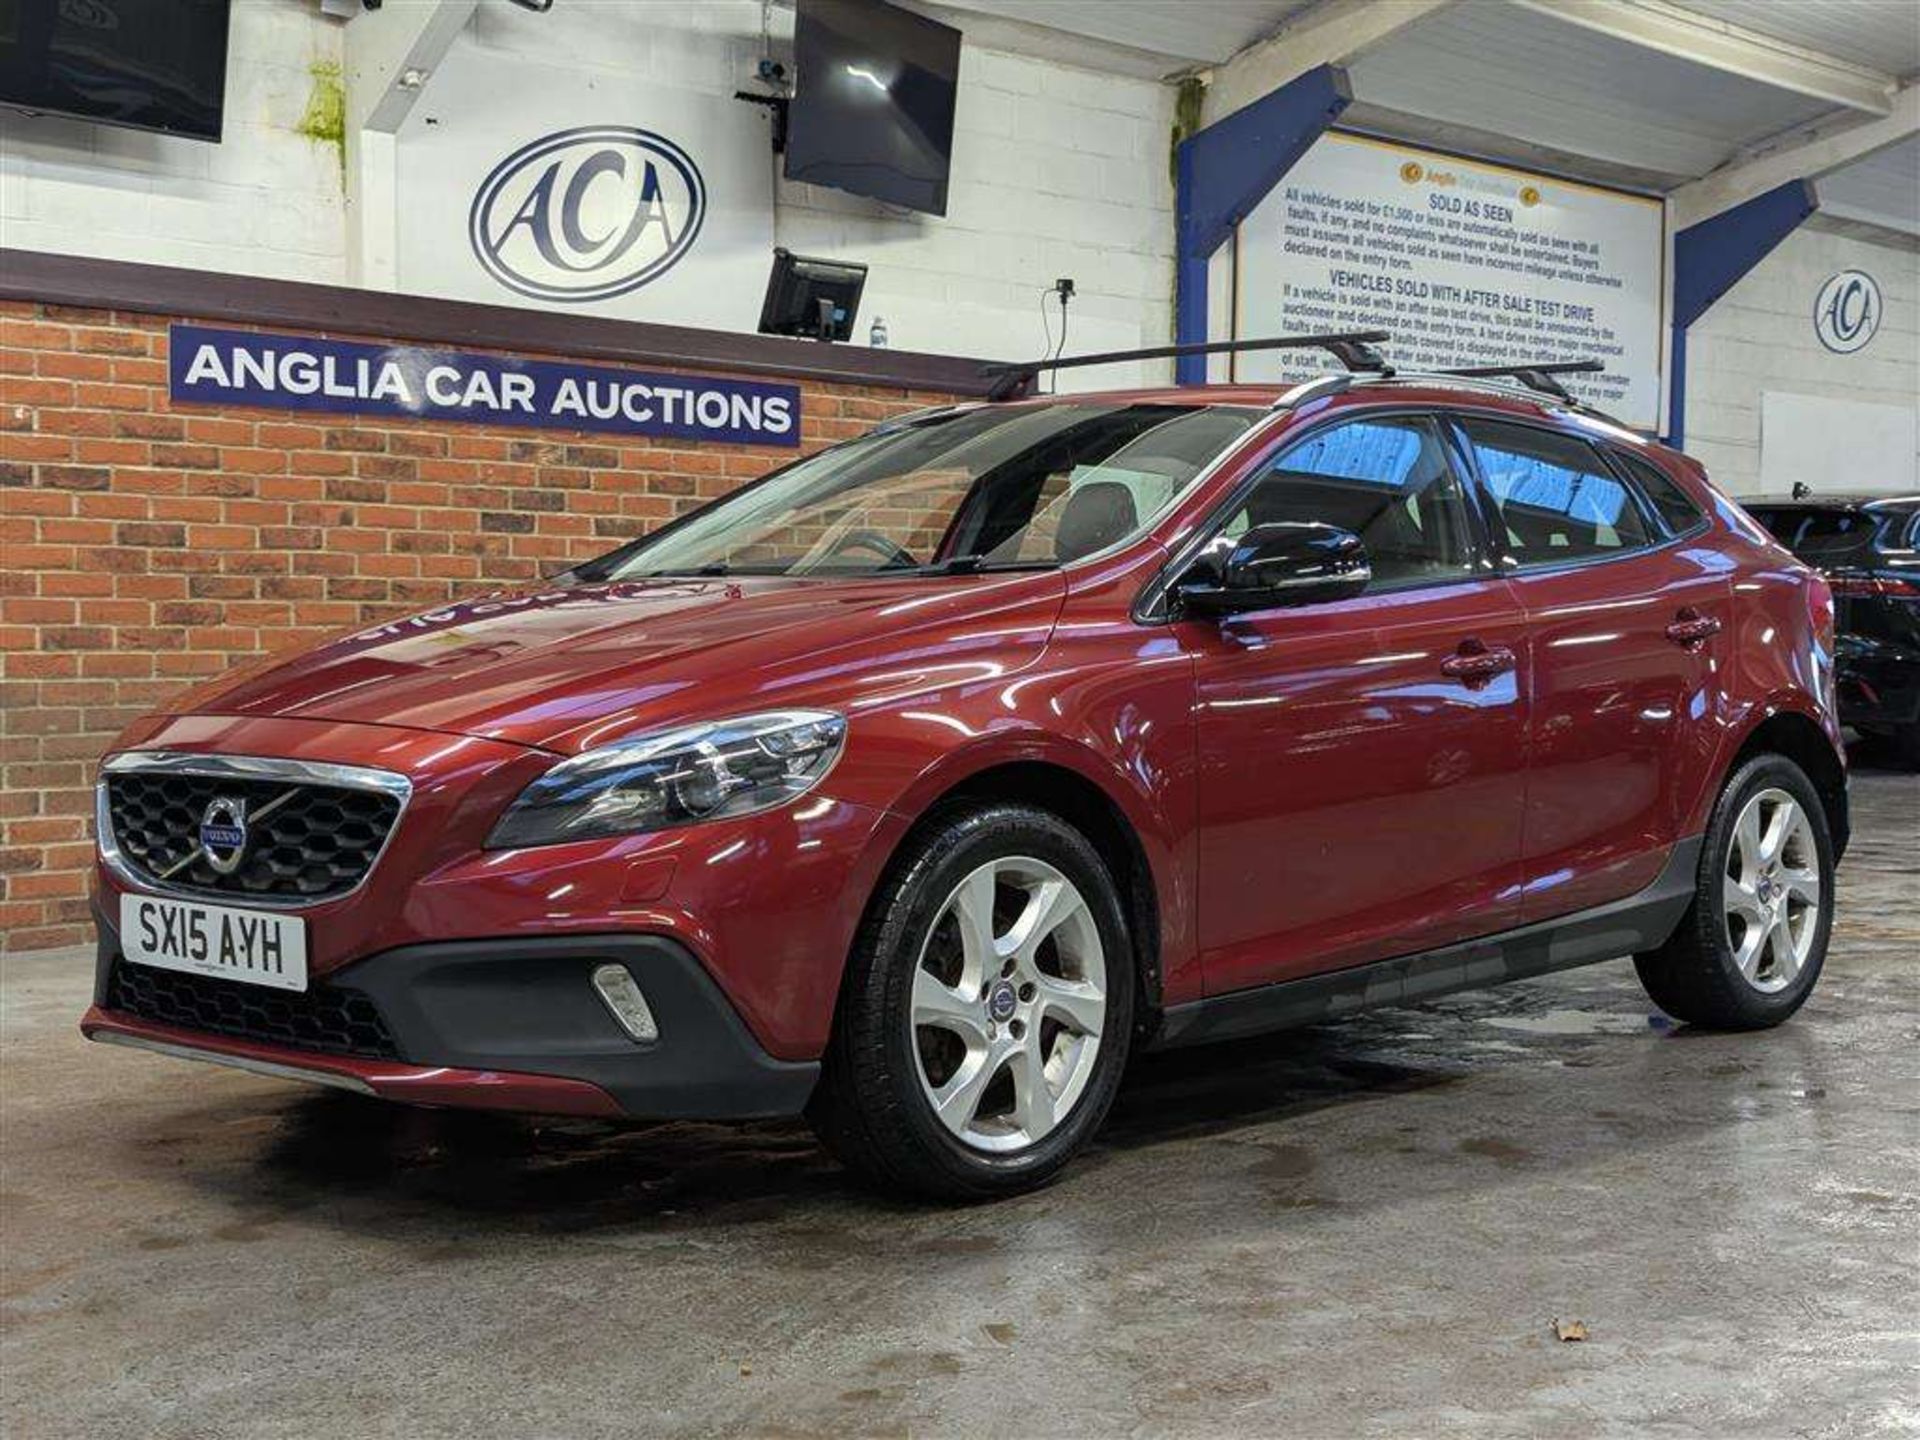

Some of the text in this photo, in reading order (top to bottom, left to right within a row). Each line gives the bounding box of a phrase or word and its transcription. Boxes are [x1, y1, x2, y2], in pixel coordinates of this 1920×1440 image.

[492, 150, 673, 272] ACA
[1285, 188, 1298, 201] All
[1301, 191, 1341, 209] vehicles
[1343, 199, 1365, 213] sold
[1367, 202, 1381, 215] for
[1383, 205, 1413, 222] £1,500
[1415, 213, 1424, 223] or
[1427, 212, 1445, 227] less
[1447, 218, 1461, 230] are
[1463, 219, 1518, 242] automatically
[1520, 231, 1538, 244] sold
[1540, 236, 1549, 246] as
[1551, 238, 1570, 250] seen
[1572, 239, 1588, 252] with
[1321, 211, 1329, 223] if
[1352, 218, 1370, 232] and
[1372, 223, 1385, 234] no
[1387, 224, 1437, 243] complaints
[1438, 232, 1487, 251] whatsoever
[1489, 240, 1509, 254] shall
[1511, 243, 1521, 256] be
[1429, 193, 1513, 223] SOLD AS SEEN
[1284, 241, 1413, 270] declared on the entry form.
[1285, 224, 1622, 288] must assume all vehicles sold as seen have incorrect mileage unless otherwise
[1284, 283, 1291, 296] If
[1293, 287, 1299, 297] a
[1301, 286, 1336, 302] vehicle
[1338, 291, 1347, 304] is
[1350, 294, 1371, 308] sold
[1373, 296, 1394, 311] with
[1396, 302, 1406, 312] an
[1408, 301, 1429, 315] after
[1431, 304, 1449, 318] sale
[1451, 308, 1467, 321] test
[1495, 313, 1511, 326] this
[1513, 316, 1532, 330] shall
[1535, 318, 1545, 331] be
[1546, 321, 1589, 338] announced
[1591, 327, 1601, 341] by
[1329, 269, 1594, 323] VEHICLES SOLD WITH AFTER SALE TEST DRIVE
[1283, 303, 1334, 318] auctioneer
[1337, 308, 1355, 322] and
[1357, 311, 1398, 327] declared
[1401, 318, 1412, 328] on
[1413, 317, 1428, 331] the
[1430, 321, 1453, 338] entry
[1478, 326, 1485, 338] A
[1488, 328, 1504, 341] test
[1506, 329, 1526, 343] drive
[1528, 334, 1556, 348] covers
[1283, 319, 1310, 334] faults
[1420, 335, 1455, 350] covered
[1457, 339, 1465, 351] is
[1467, 341, 1507, 358] displayed
[1509, 346, 1517, 357] in
[1519, 346, 1533, 359] the
[185, 345, 793, 434] ANGLIA CAR AUCTIONS
[140, 902, 283, 974] SX15 AYH
